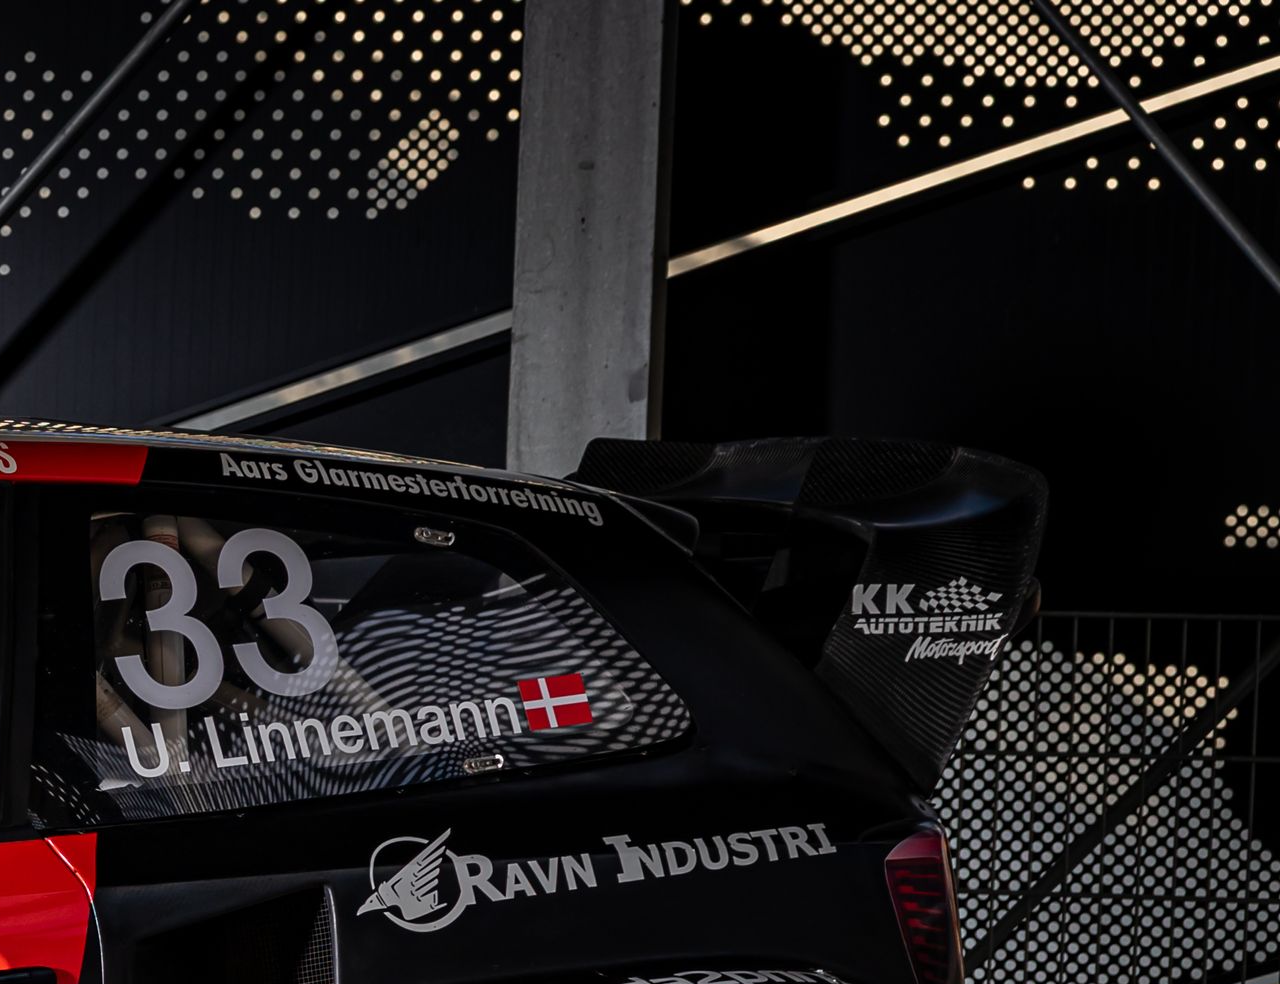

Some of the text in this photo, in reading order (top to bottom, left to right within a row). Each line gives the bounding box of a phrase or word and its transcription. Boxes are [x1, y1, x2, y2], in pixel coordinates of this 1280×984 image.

[220, 453, 604, 527] Aars Glarmesterforretning
[99, 528, 339, 710] 33
[851, 583, 915, 615] KK
[853, 612, 1003, 635] AUTOTEKNIK
[904, 633, 1009, 665] Motorsport
[121, 696, 523, 779] U. Linnemann
[453, 822, 838, 906] RAVN INDUSTRI
